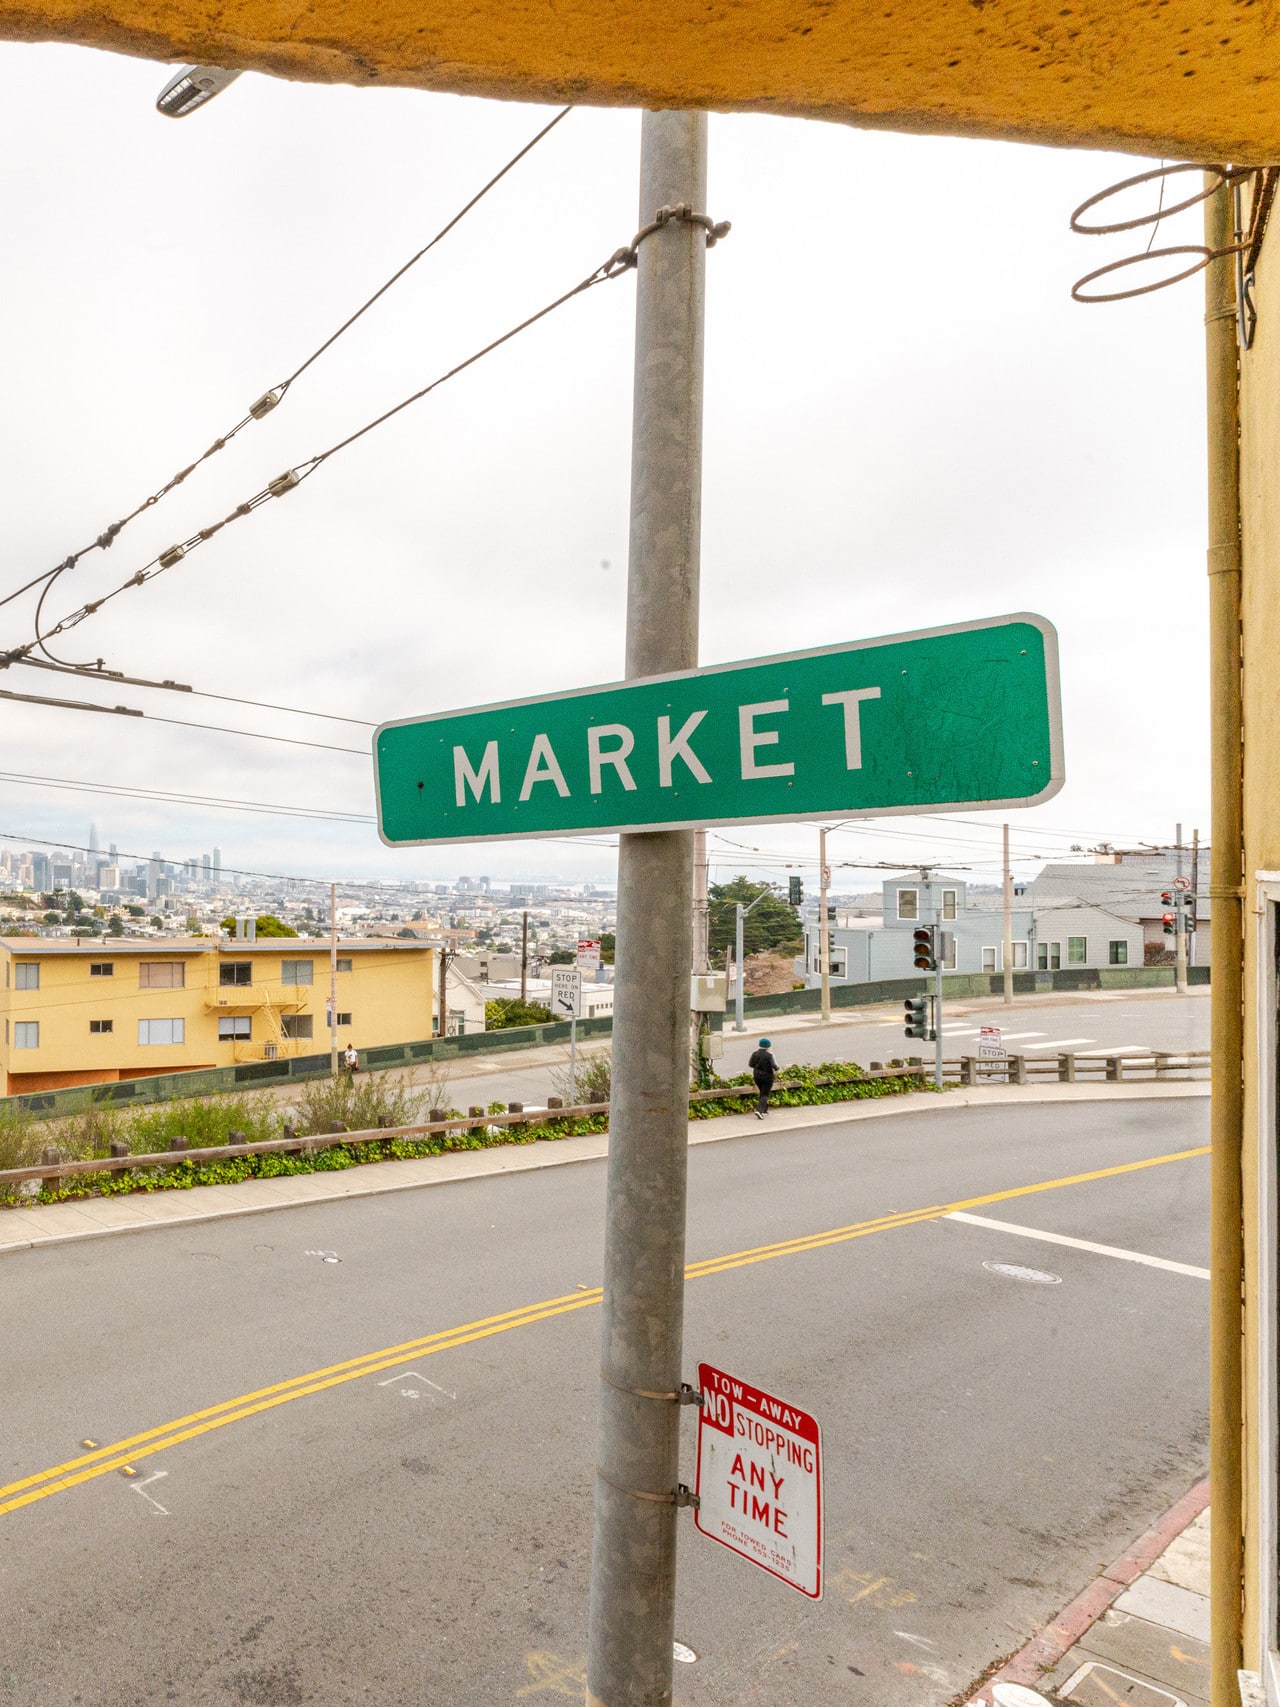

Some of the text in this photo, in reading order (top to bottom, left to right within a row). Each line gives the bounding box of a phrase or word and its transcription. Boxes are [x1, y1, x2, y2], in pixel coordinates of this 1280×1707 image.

[452, 686, 881, 807] MARKET
[556, 974, 577, 982] STOP
[558, 991, 574, 999] RED
[982, 1049, 1002, 1057] STOP
[703, 1386, 813, 1473] NO STOPPING
[731, 1453, 784, 1500] ANY
[727, 1481, 788, 1539] TIME
[721, 1521, 792, 1566] FOR TOWED CARS
[722, 1528, 748, 1547] PHONE
